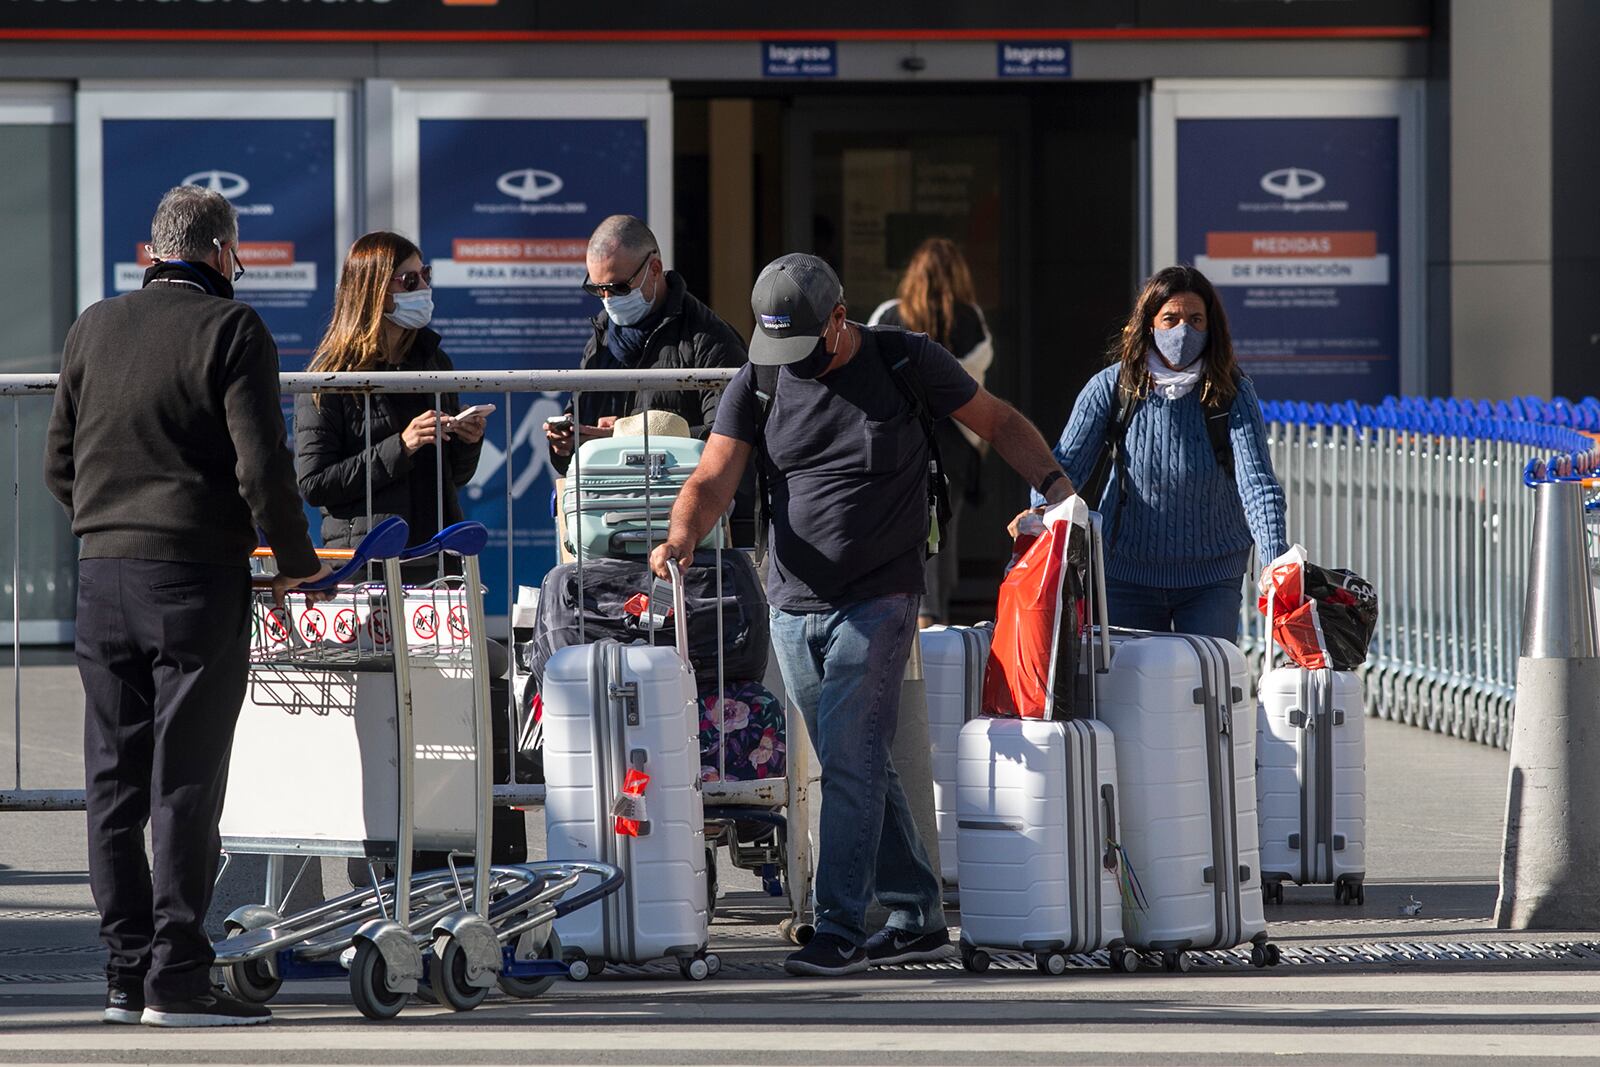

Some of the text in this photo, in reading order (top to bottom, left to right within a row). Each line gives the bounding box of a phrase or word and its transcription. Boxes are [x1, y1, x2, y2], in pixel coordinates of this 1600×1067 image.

[768, 45, 831, 63] Ingreso
[1003, 45, 1066, 64] Ingreso
[460, 243, 521, 257] INGRESO
[1252, 237, 1331, 252] MEDIDAS
[467, 266, 586, 278] PARA PASAJERO
[1232, 261, 1352, 277] DE PREVENCIÓN
